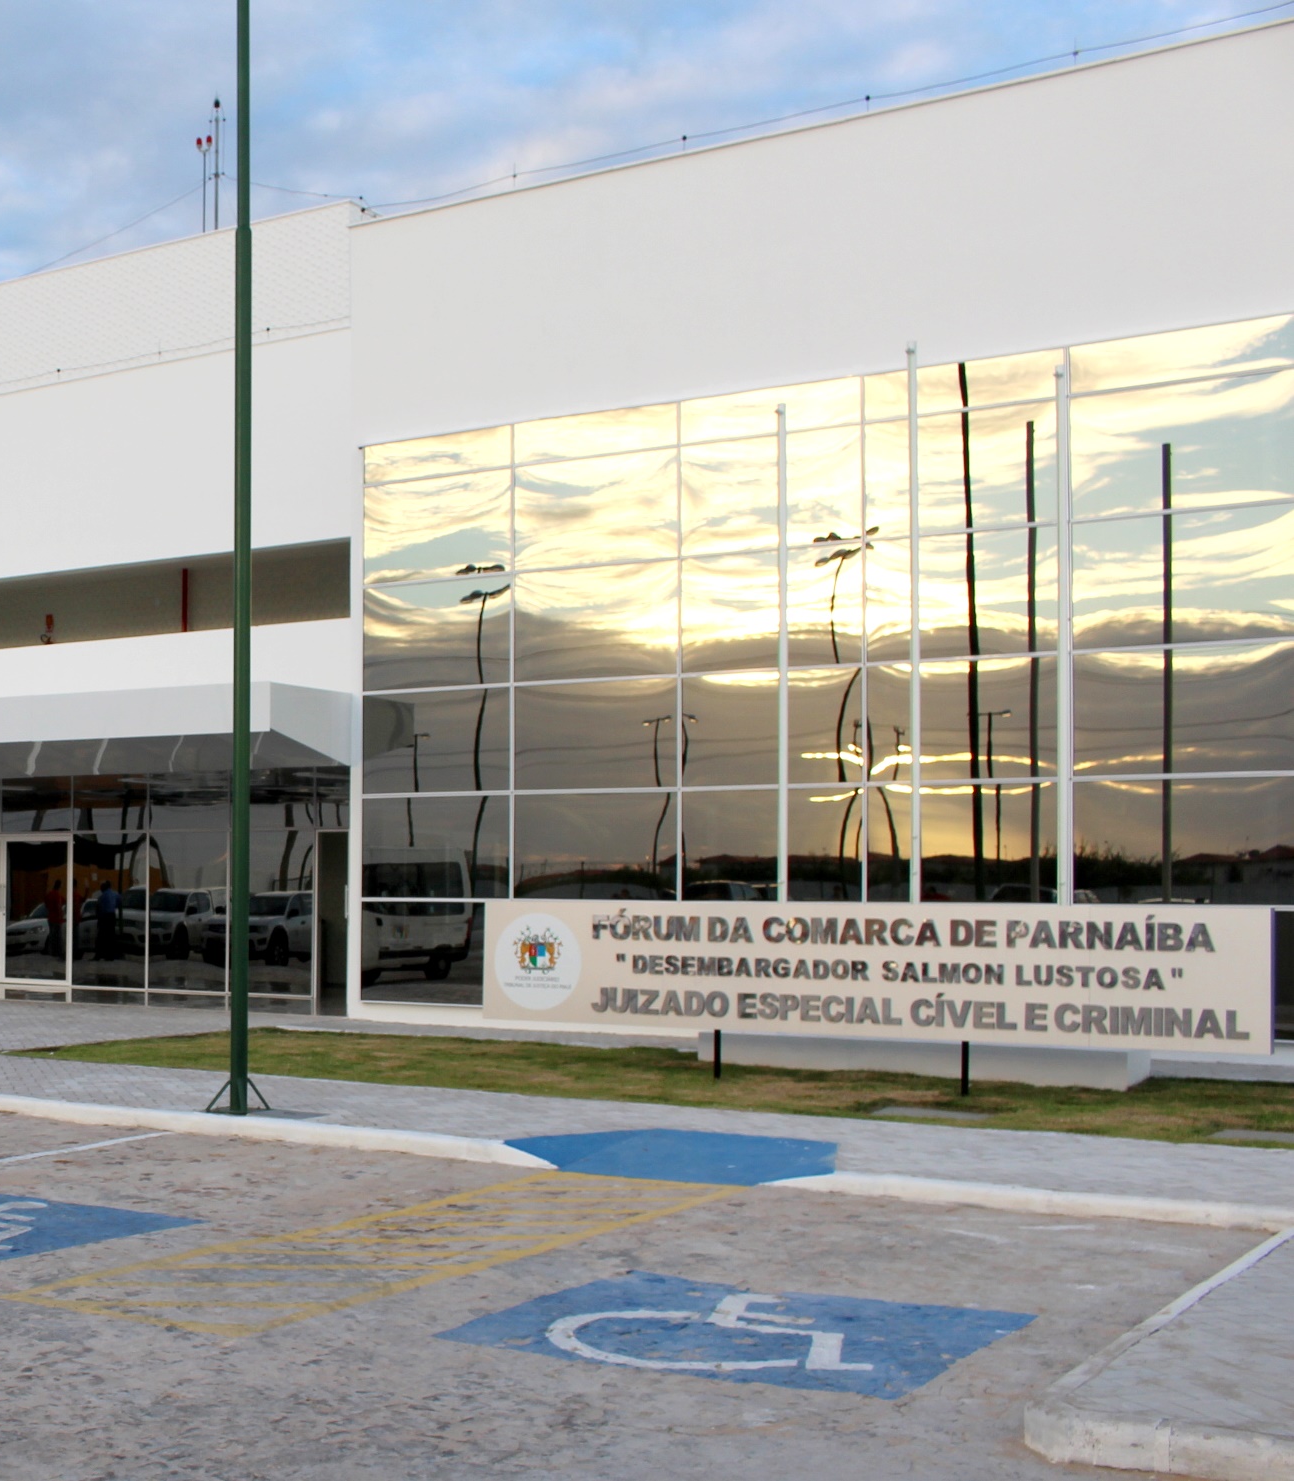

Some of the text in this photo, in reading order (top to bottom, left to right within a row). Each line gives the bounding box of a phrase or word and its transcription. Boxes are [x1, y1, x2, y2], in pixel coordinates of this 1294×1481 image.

[592, 908, 1216, 952] FÓRUM DA COMARCA DE PARNAÍBA
[881, 960, 1004, 985] SALMON
[591, 987, 1250, 1040] JUIZADO ESPECIAL CÍVEL E CRIMINAL
